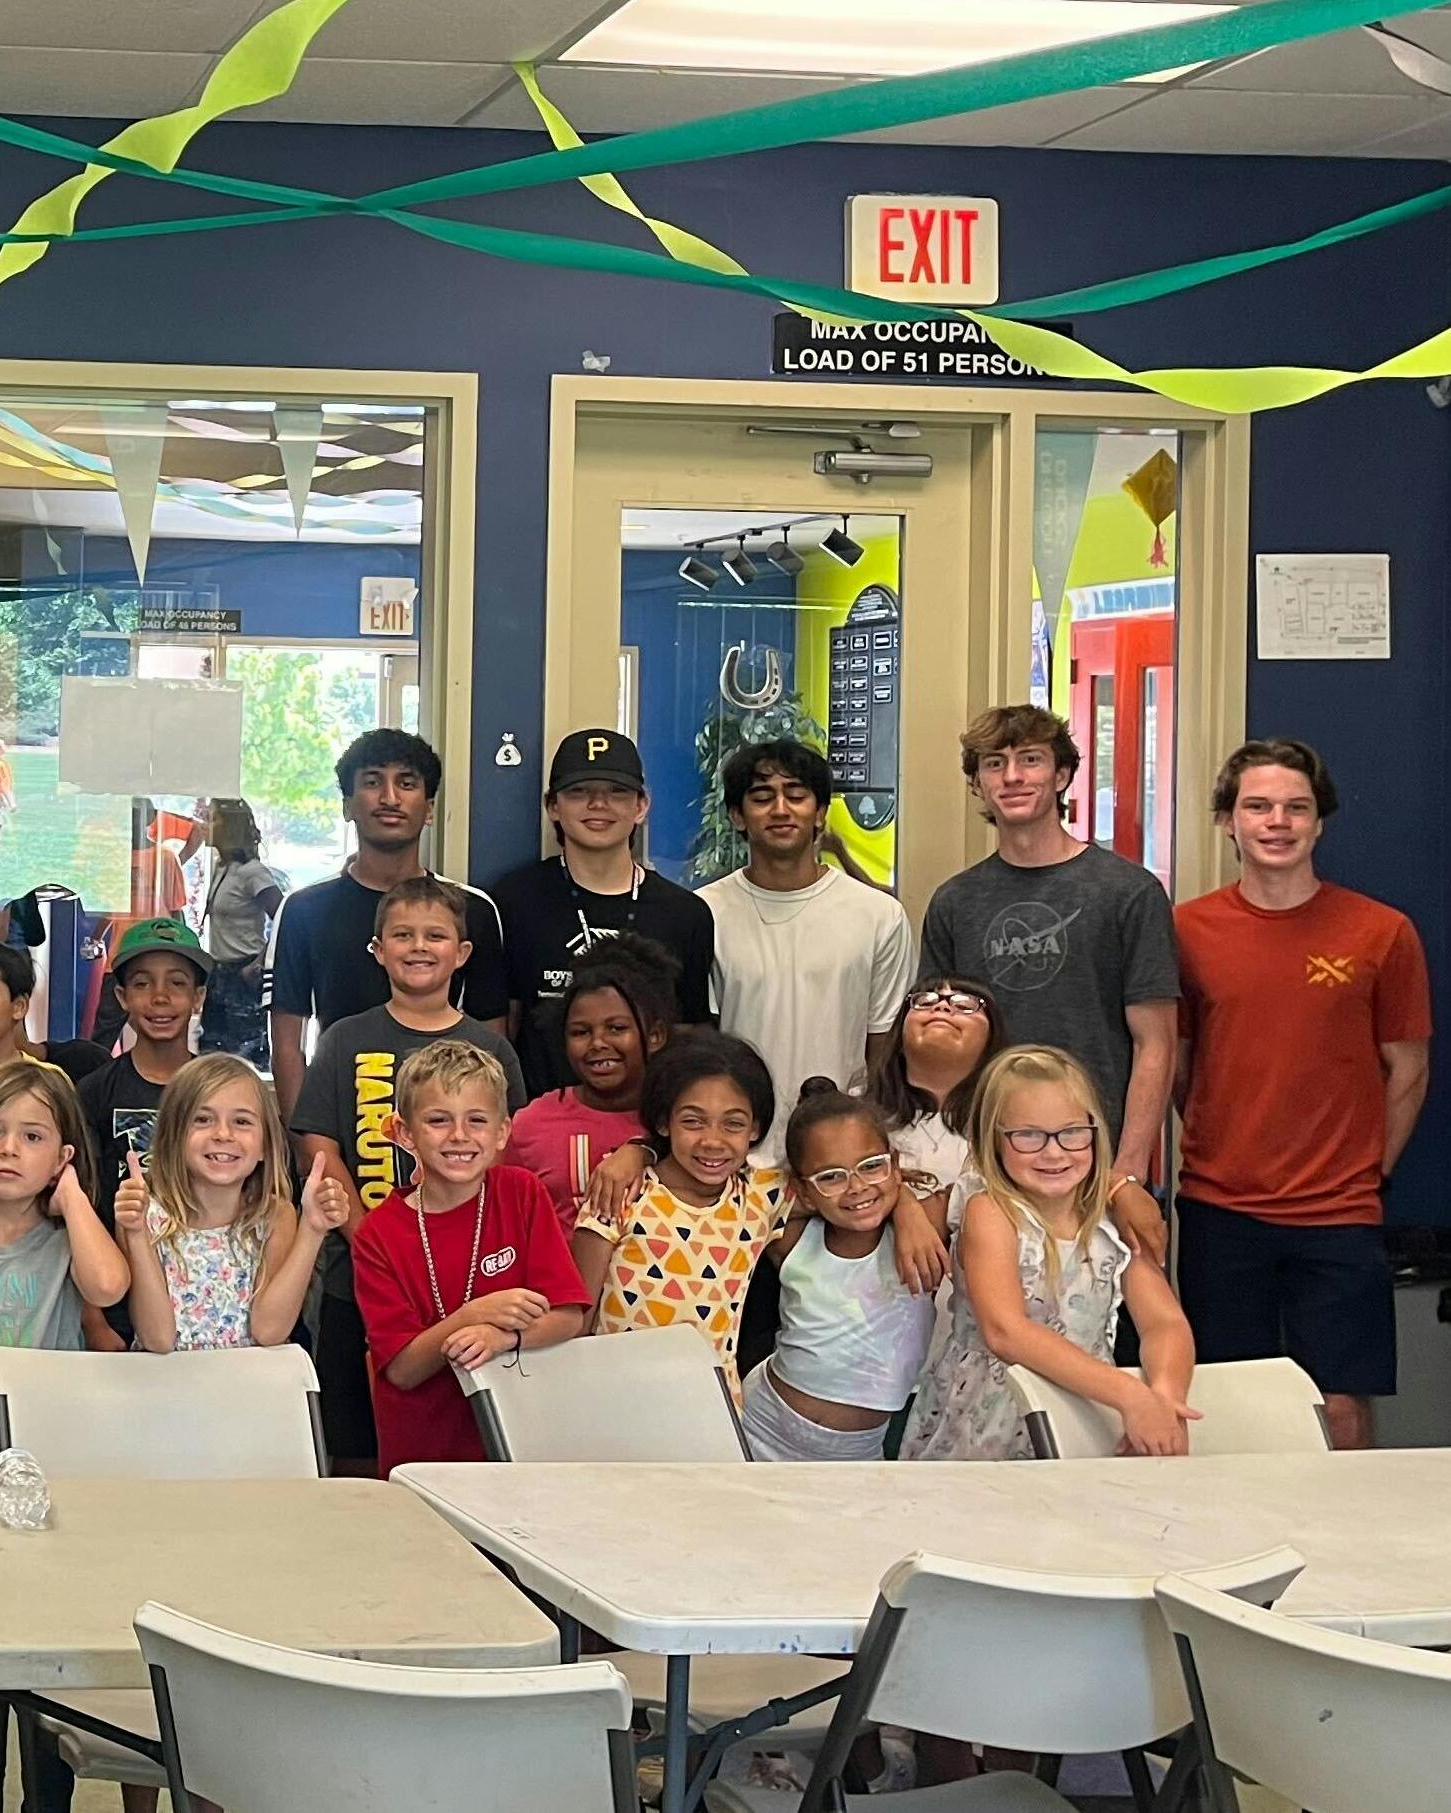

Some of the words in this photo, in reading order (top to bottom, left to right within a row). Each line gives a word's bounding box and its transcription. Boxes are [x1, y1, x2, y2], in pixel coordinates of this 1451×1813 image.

[880, 208, 978, 284] EXIT
[810, 320, 867, 341] MAX
[784, 349, 854, 371] LOAD
[862, 351, 897, 372] OF
[903, 352, 929, 373] 51
[370, 601, 404, 630] EXIT
[587, 737, 609, 760] P
[990, 935, 1062, 956] NASA
[356, 1052, 396, 1210] NARUTO
